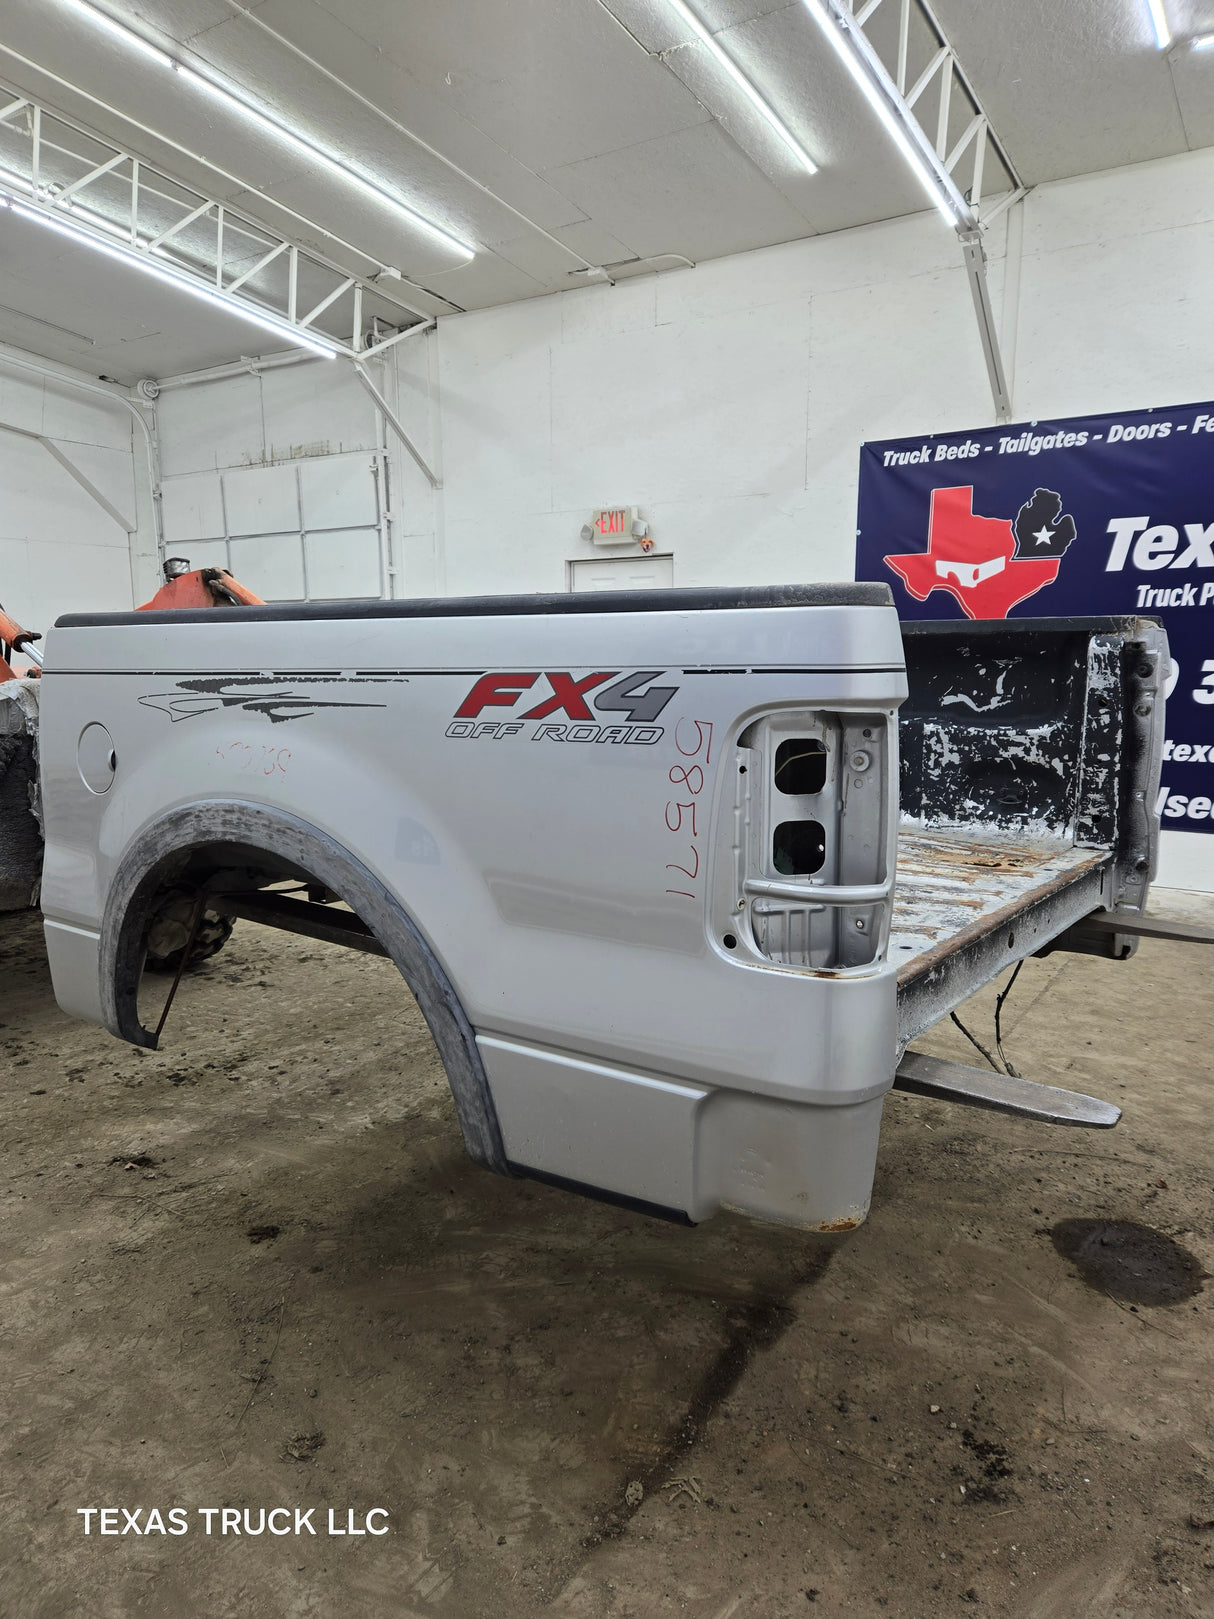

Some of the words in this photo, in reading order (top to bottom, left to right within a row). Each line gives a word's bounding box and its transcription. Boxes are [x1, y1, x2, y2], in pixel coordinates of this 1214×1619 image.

[883, 445, 932, 467] Truck
[934, 440, 981, 462] Beds
[998, 431, 1089, 456] Tailgates
[1106, 422, 1173, 443] Doors
[600, 510, 625, 534] EXIT
[1136, 583, 1198, 608] Truck
[453, 671, 680, 722] FX4
[445, 721, 524, 740] OFF
[531, 723, 664, 745] ROAD
